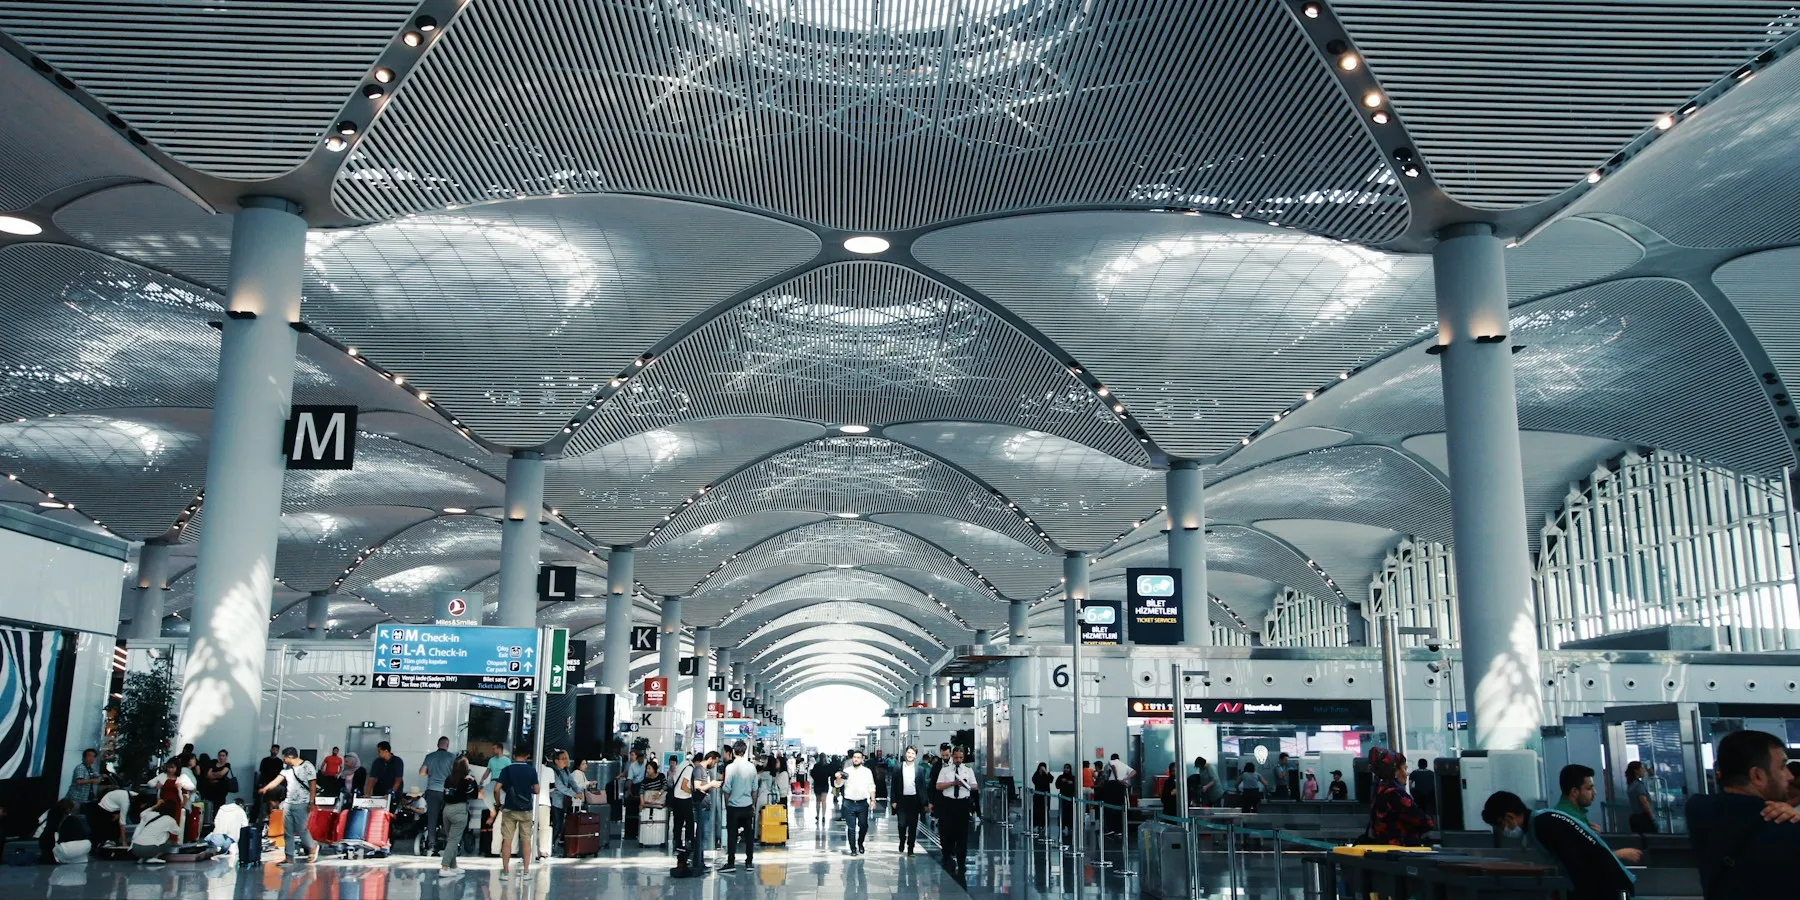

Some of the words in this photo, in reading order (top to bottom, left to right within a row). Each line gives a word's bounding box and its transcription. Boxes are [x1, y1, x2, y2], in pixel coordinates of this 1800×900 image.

[292, 412, 346, 461] M
[548, 569, 566, 597] L
[1140, 577, 1153, 594] 6
[1146, 598, 1167, 607] BİLET
[1087, 608, 1097, 622] 6
[1135, 606, 1178, 615] HİZMETLERİ
[1091, 625, 1109, 633] BİLET
[405, 629, 418, 642] M
[421, 633, 460, 643] Check-in
[636, 628, 652, 648] K
[1082, 632, 1118, 640] HİZMETLERİ
[403, 643, 426, 657] L-A
[428, 647, 468, 658] Check-in
[685, 658, 694, 674] J
[338, 674, 367, 686] 1-22
[1053, 664, 1070, 688] 6
[711, 677, 723, 690] H
[731, 689, 741, 700] G
[746, 698, 752, 708] F
[1244, 703, 1283, 712] Nordwind
[756, 705, 763, 714] E
[764, 710, 771, 718] D
[642, 713, 652, 726] K
[771, 715, 777, 723] C
[925, 716, 933, 727] 5
